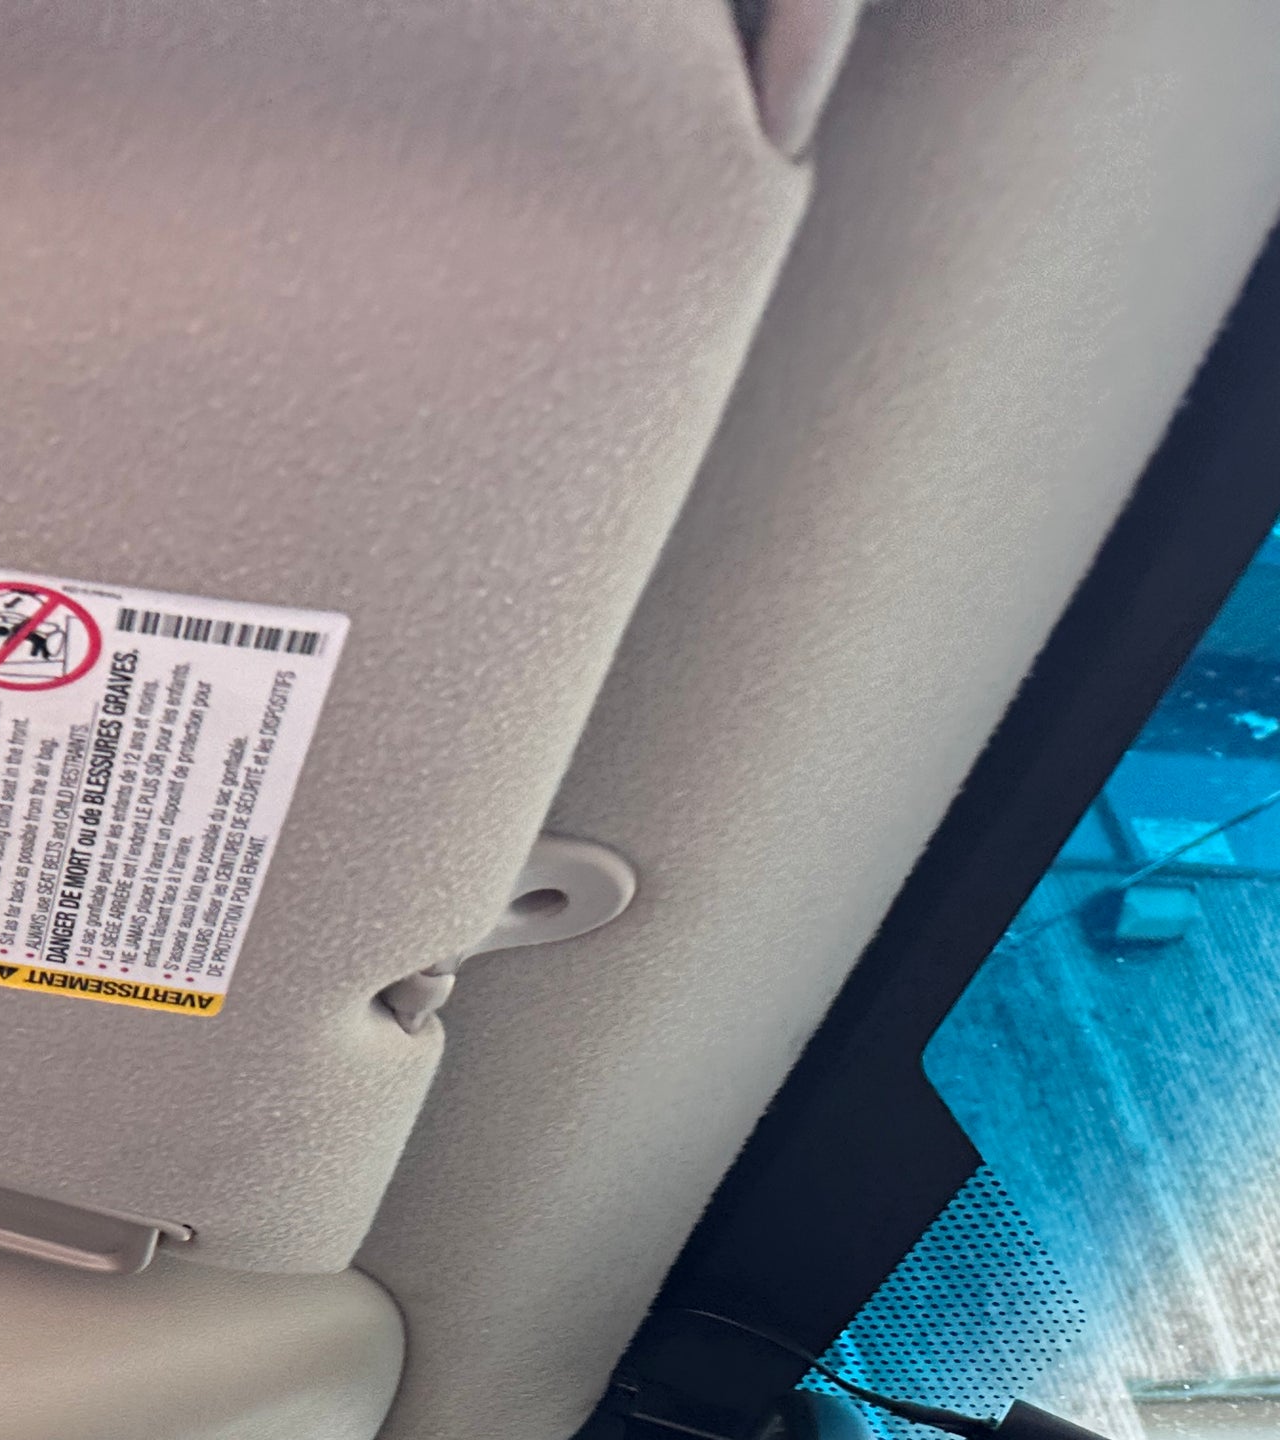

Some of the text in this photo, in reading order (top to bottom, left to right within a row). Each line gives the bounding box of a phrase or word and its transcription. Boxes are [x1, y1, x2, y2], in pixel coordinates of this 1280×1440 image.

[191, 680, 215, 708] pour
[130, 717, 149, 729] et
[158, 707, 179, 725] les
[127, 730, 146, 751] ans
[153, 726, 176, 752] pour
[174, 708, 207, 763] protection
[252, 737, 274, 753] les
[3, 746, 24, 765] the
[121, 751, 141, 767] 12
[249, 753, 269, 766] et
[0, 765, 20, 777] in
[31, 761, 50, 777] air
[117, 768, 137, 783] de
[171, 764, 189, 778] de
[27, 777, 47, 796] the
[137, 777, 160, 805] PLUS
[45, 646, 139, 964] DANGER DE MORT ou de BLESSURES GRAVES.
[52, 788, 75, 820] CHILD
[108, 783, 132, 822] enfants
[214, 787, 232, 806] sac
[22, 796, 43, 821] from
[133, 806, 152, 820] LE
[207, 807, 227, 822] du
[48, 820, 68, 840] and
[104, 823, 123, 838] les
[229, 814, 249, 830] DE
[13, 822, 40, 864] possible
[156, 827, 172, 840] un
[194, 822, 224, 864] possible
[42, 840, 63, 869] BELTS
[99, 839, 118, 860] tuer
[213, 830, 245, 882] CEINTURES
[14, 865, 29, 877] as
[94, 861, 116, 883] peut
[120, 862, 137, 878] est
[140, 875, 158, 883] à
[162, 875, 181, 883] à
[192, 864, 211, 884] que
[6, 878, 27, 903] back
[36, 870, 56, 895] SEAT
[209, 882, 228, 897] les
[229, 875, 254, 902] POUR
[133, 883, 158, 914] placer
[157, 883, 178, 905] face
[183, 883, 203, 902] loin
[3, 903, 21, 918] far
[35, 896, 51, 913] use
[199, 896, 224, 927] utiliser
[147, 905, 172, 938] faisant
[176, 902, 197, 928] aussi
[3, 919, 18, 931] as
[25, 913, 47, 950] ALWAYS
[123, 914, 147, 950] JAMAIS
[210, 903, 245, 963] PROTECTION
[80, 928, 96, 945] sac
[76, 945, 92, 957] Le
[97, 948, 115, 961] Le
[120, 950, 137, 964] NE
[139, 938, 162, 968] enfant
[185, 927, 214, 974] TOUJOURS
[206, 962, 225, 977] DE
[25, 967, 216, 1009] AVERTISSEMENT
